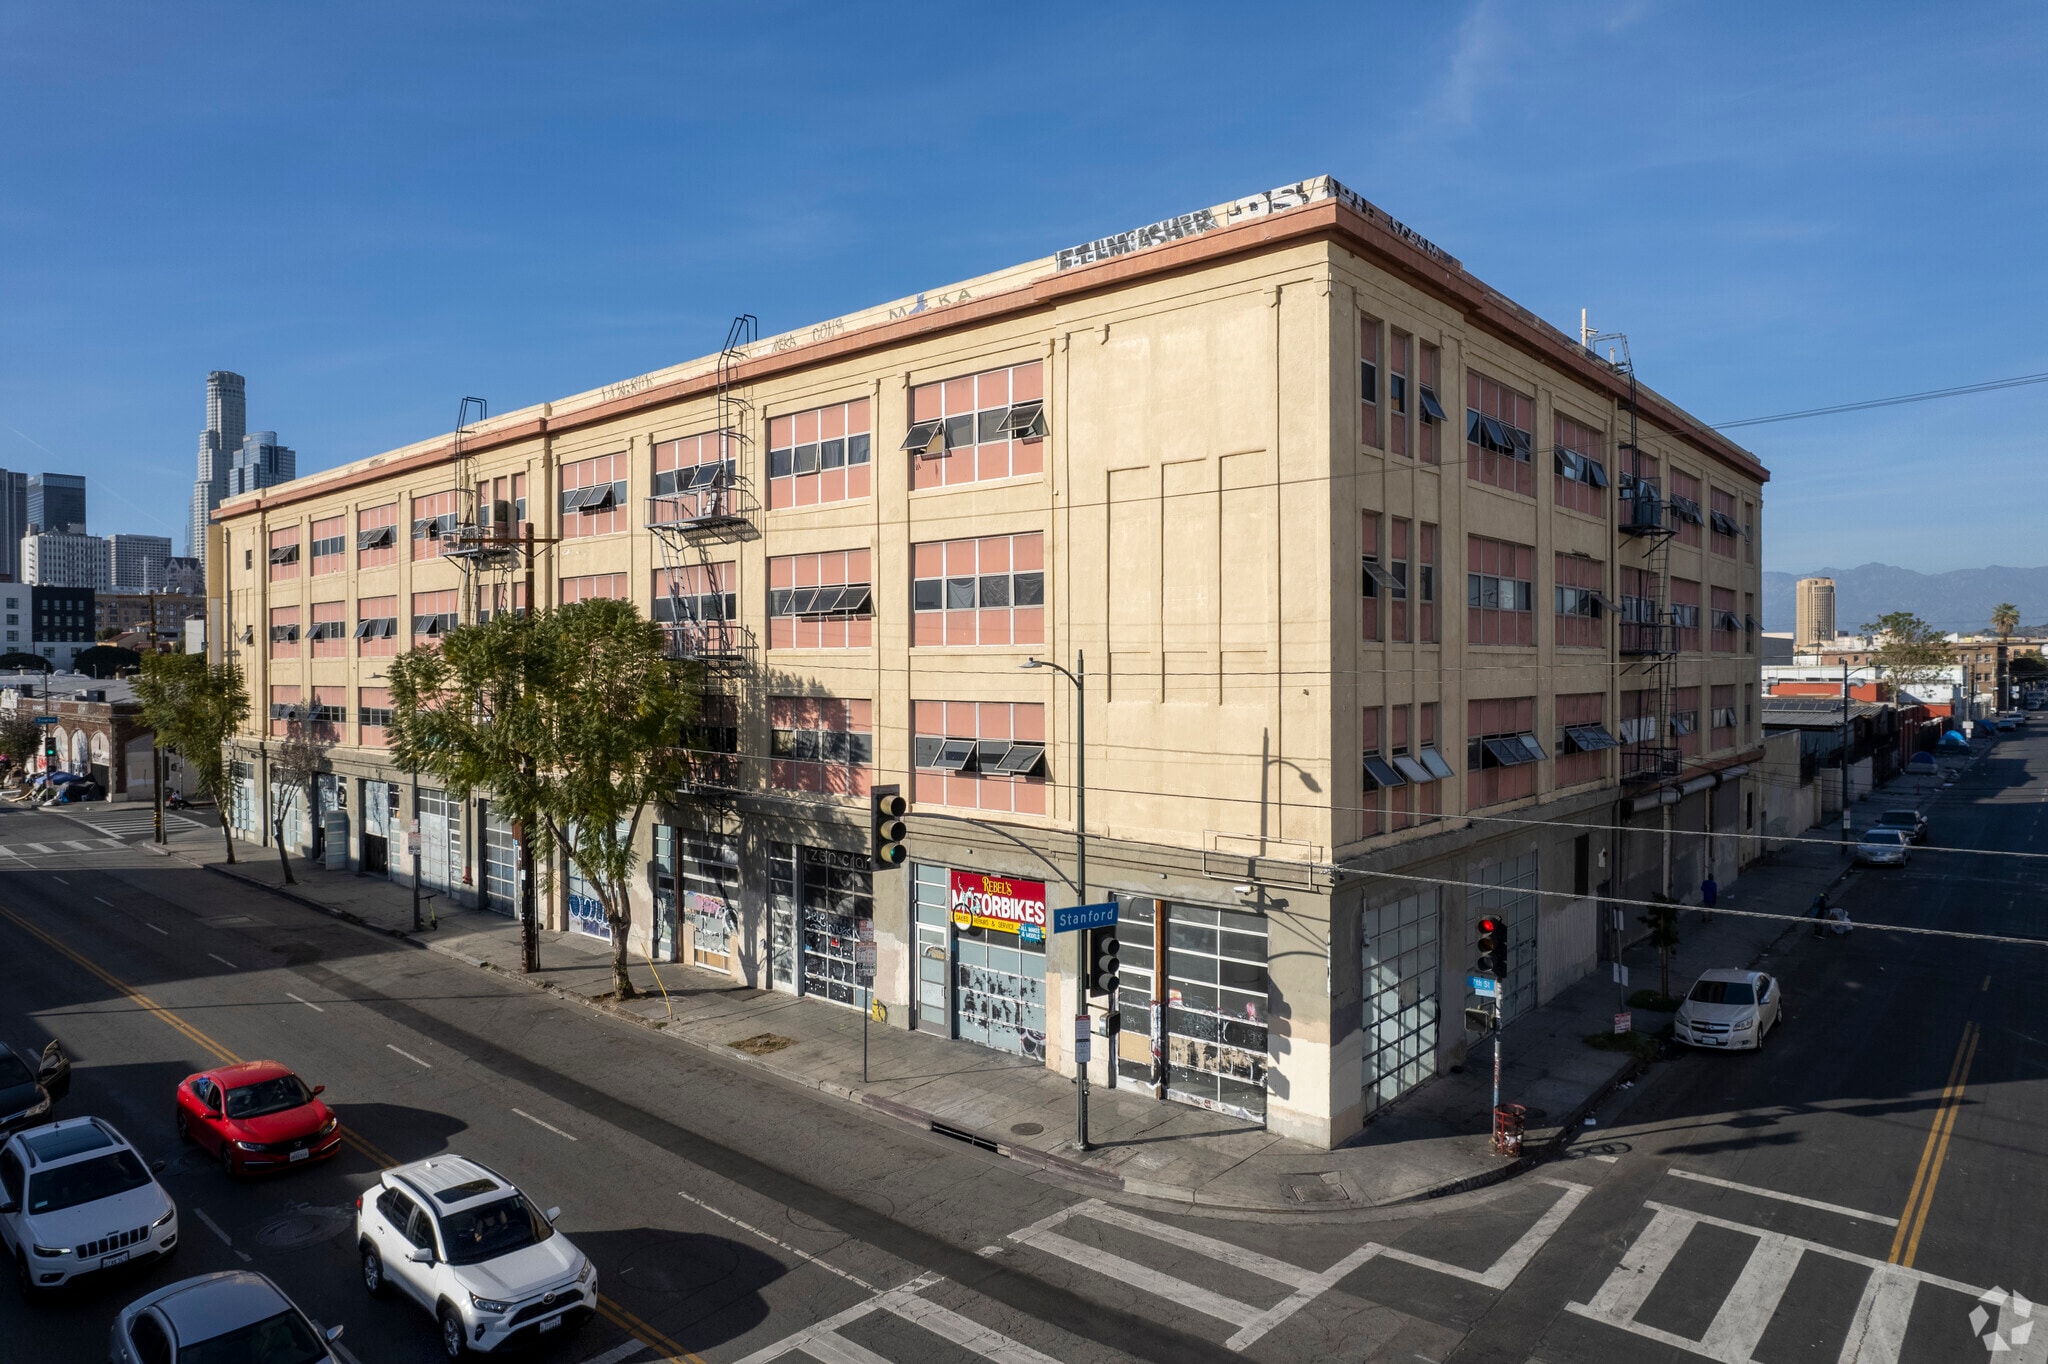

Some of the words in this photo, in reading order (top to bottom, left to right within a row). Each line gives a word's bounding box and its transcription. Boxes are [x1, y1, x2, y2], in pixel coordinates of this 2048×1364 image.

[982, 876, 1013, 896] REBEL'S
[952, 889, 1045, 925] MOTORBIKES
[998, 921, 1014, 929] SERVICE
[1060, 908, 1113, 927] Stanford
